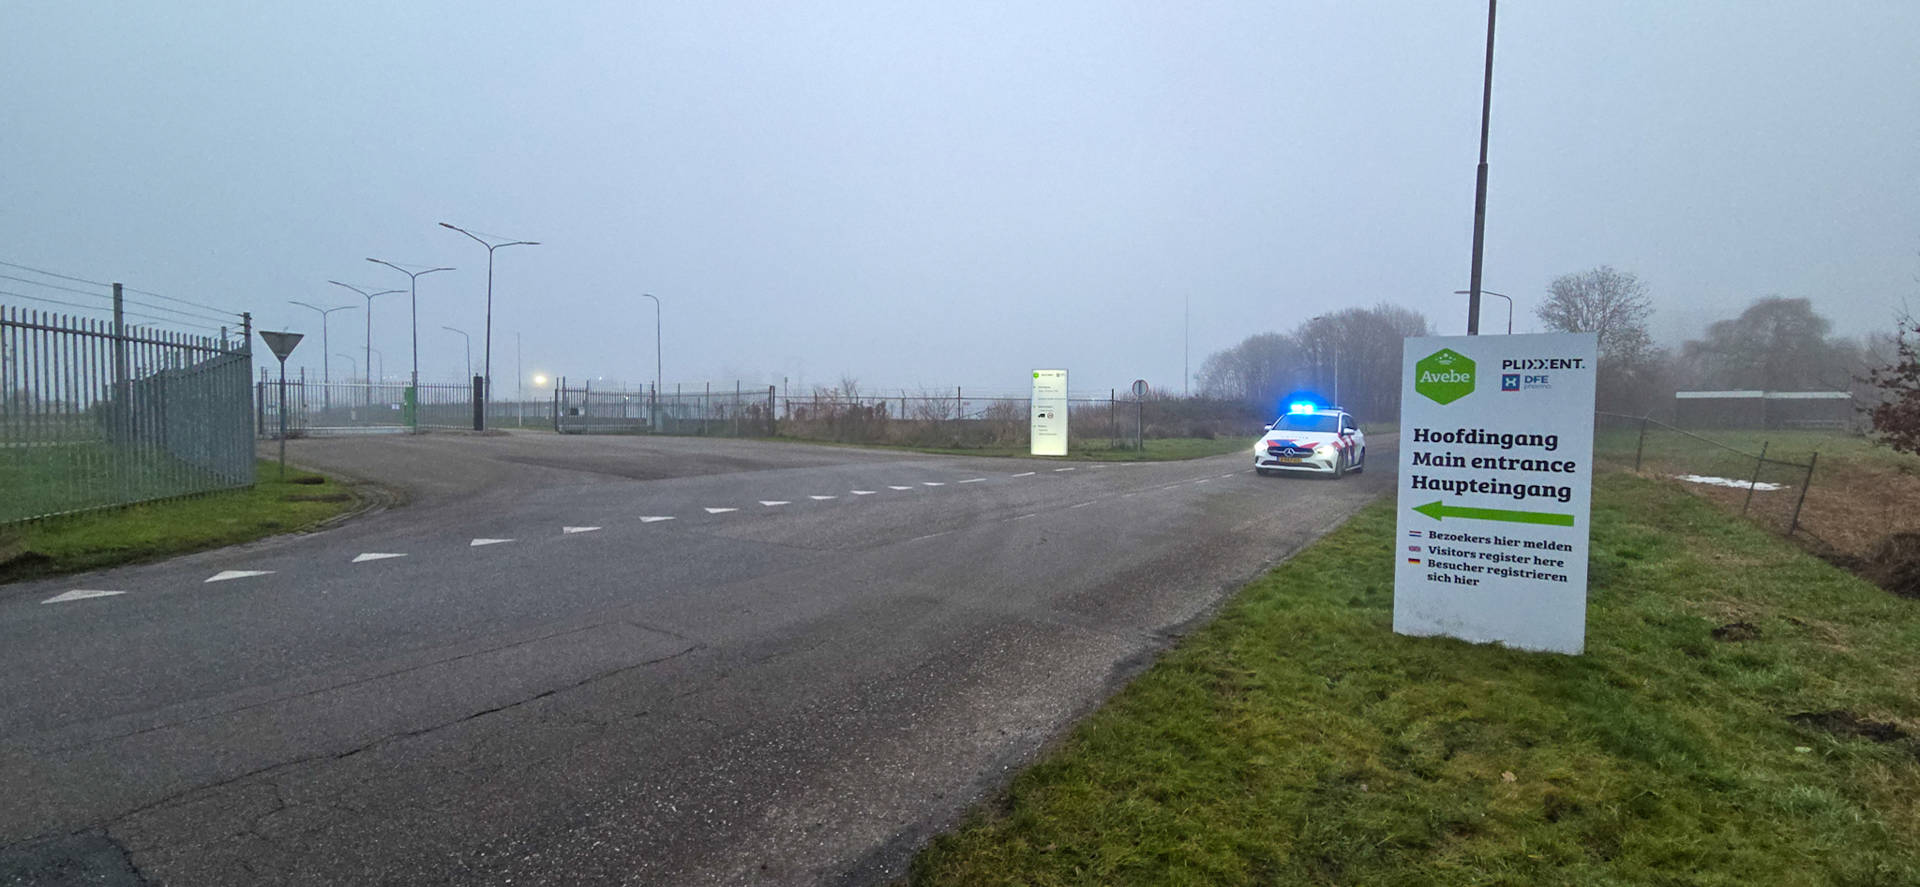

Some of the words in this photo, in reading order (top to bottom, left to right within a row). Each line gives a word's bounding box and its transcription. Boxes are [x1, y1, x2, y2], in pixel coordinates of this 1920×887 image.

[1419, 369, 1470, 383] Avebe
[1524, 375, 1549, 384] DFE
[1413, 428, 1558, 451] Hoofdingang
[1412, 452, 1466, 468] Main
[1472, 457, 1576, 473] entrance
[1411, 475, 1572, 502] Haupteingang
[1429, 530, 1491, 545] Bezoekers
[1494, 536, 1521, 547] hier
[1523, 539, 1572, 552] melden
[1428, 546, 1476, 559] Visitors
[1479, 551, 1531, 565] register
[1534, 554, 1564, 567] here
[1427, 572, 1451, 583] sich
[1454, 575, 1479, 586] hier
[1428, 559, 1484, 573] Besucher
[1487, 566, 1568, 582] registrieren
